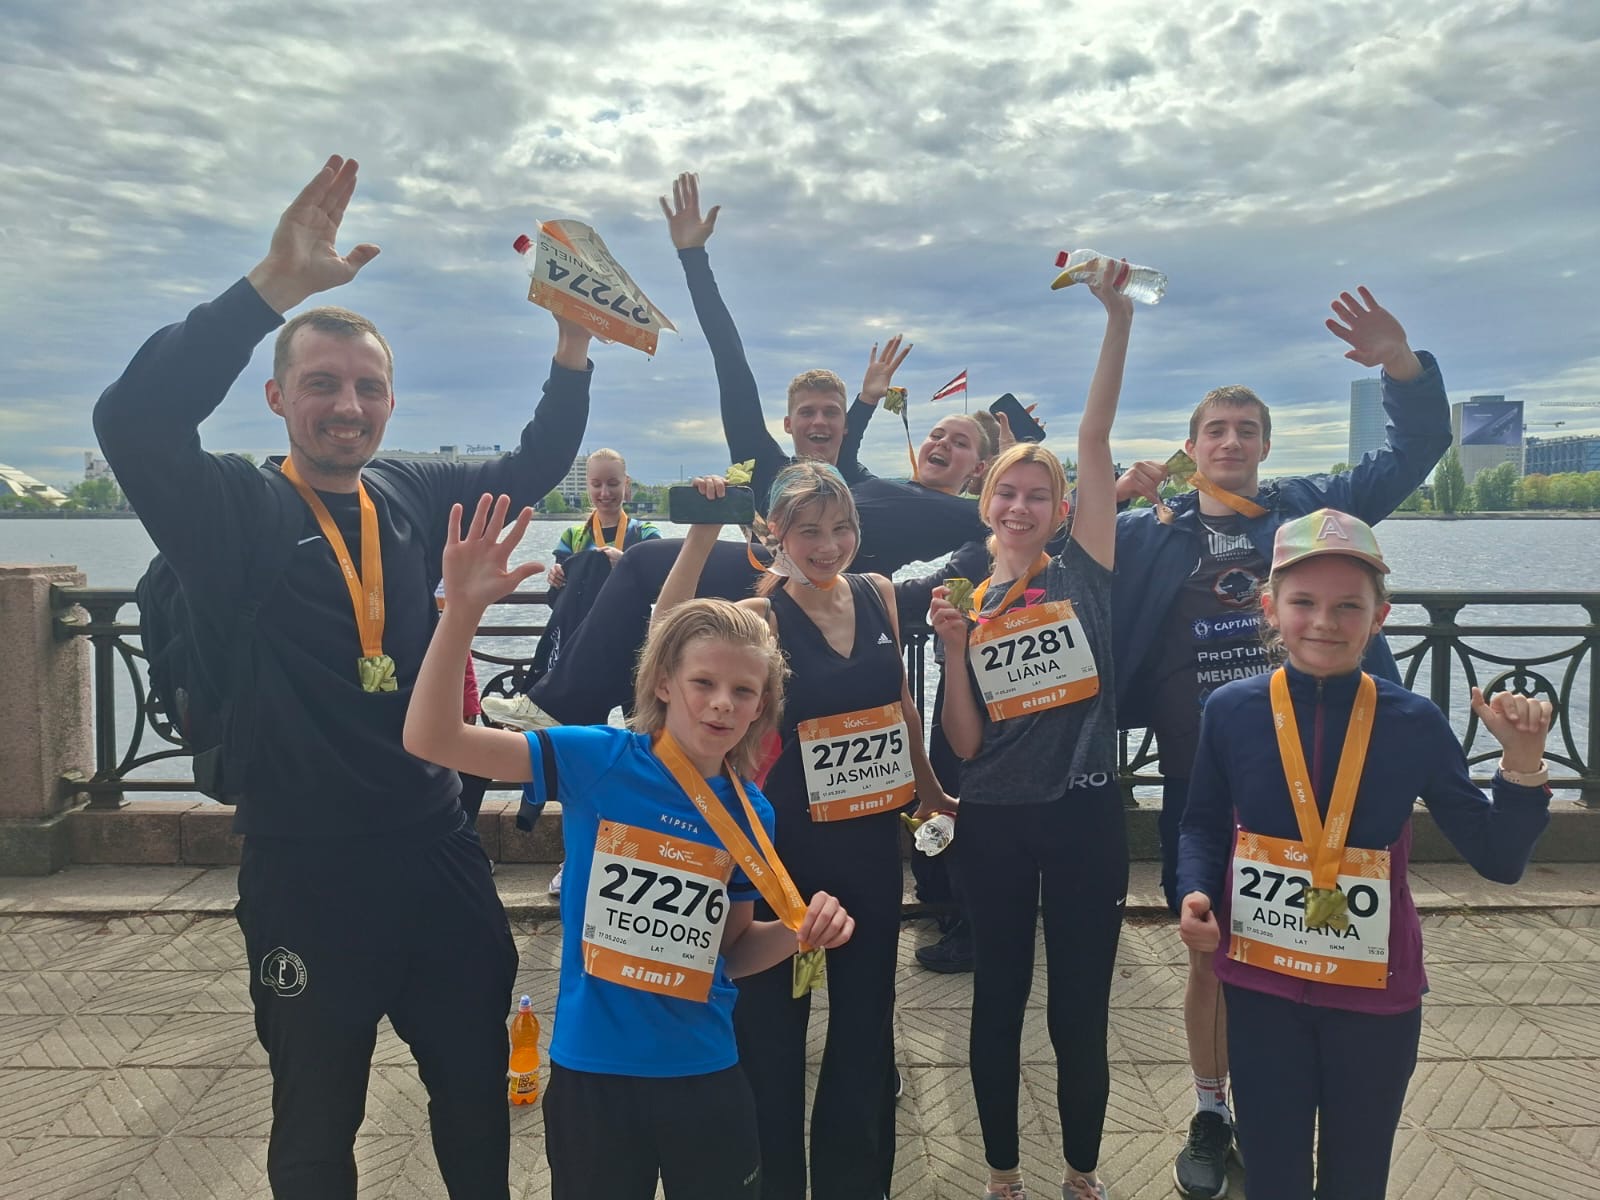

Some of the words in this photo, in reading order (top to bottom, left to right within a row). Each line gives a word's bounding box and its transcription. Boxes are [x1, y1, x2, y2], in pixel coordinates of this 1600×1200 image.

[540, 241, 595, 275] ANIELS
[1317, 515, 1348, 541] A
[1214, 618, 1261, 631] CAPTAIN
[981, 625, 1075, 671] 27281
[1197, 644, 1288, 662] PROTUNIN
[1007, 660, 1060, 682] LIĀNA
[1197, 664, 1273, 683] MEHANIK
[812, 729, 903, 771] 27275
[826, 761, 900, 786] JASMĪNA
[1068, 773, 1107, 790] RO
[660, 813, 699, 834] KIPSTA
[599, 864, 724, 924] 27276
[1240, 867, 1379, 918] 2720
[606, 908, 712, 949] TEODORS
[650, 945, 665, 953] LAT
